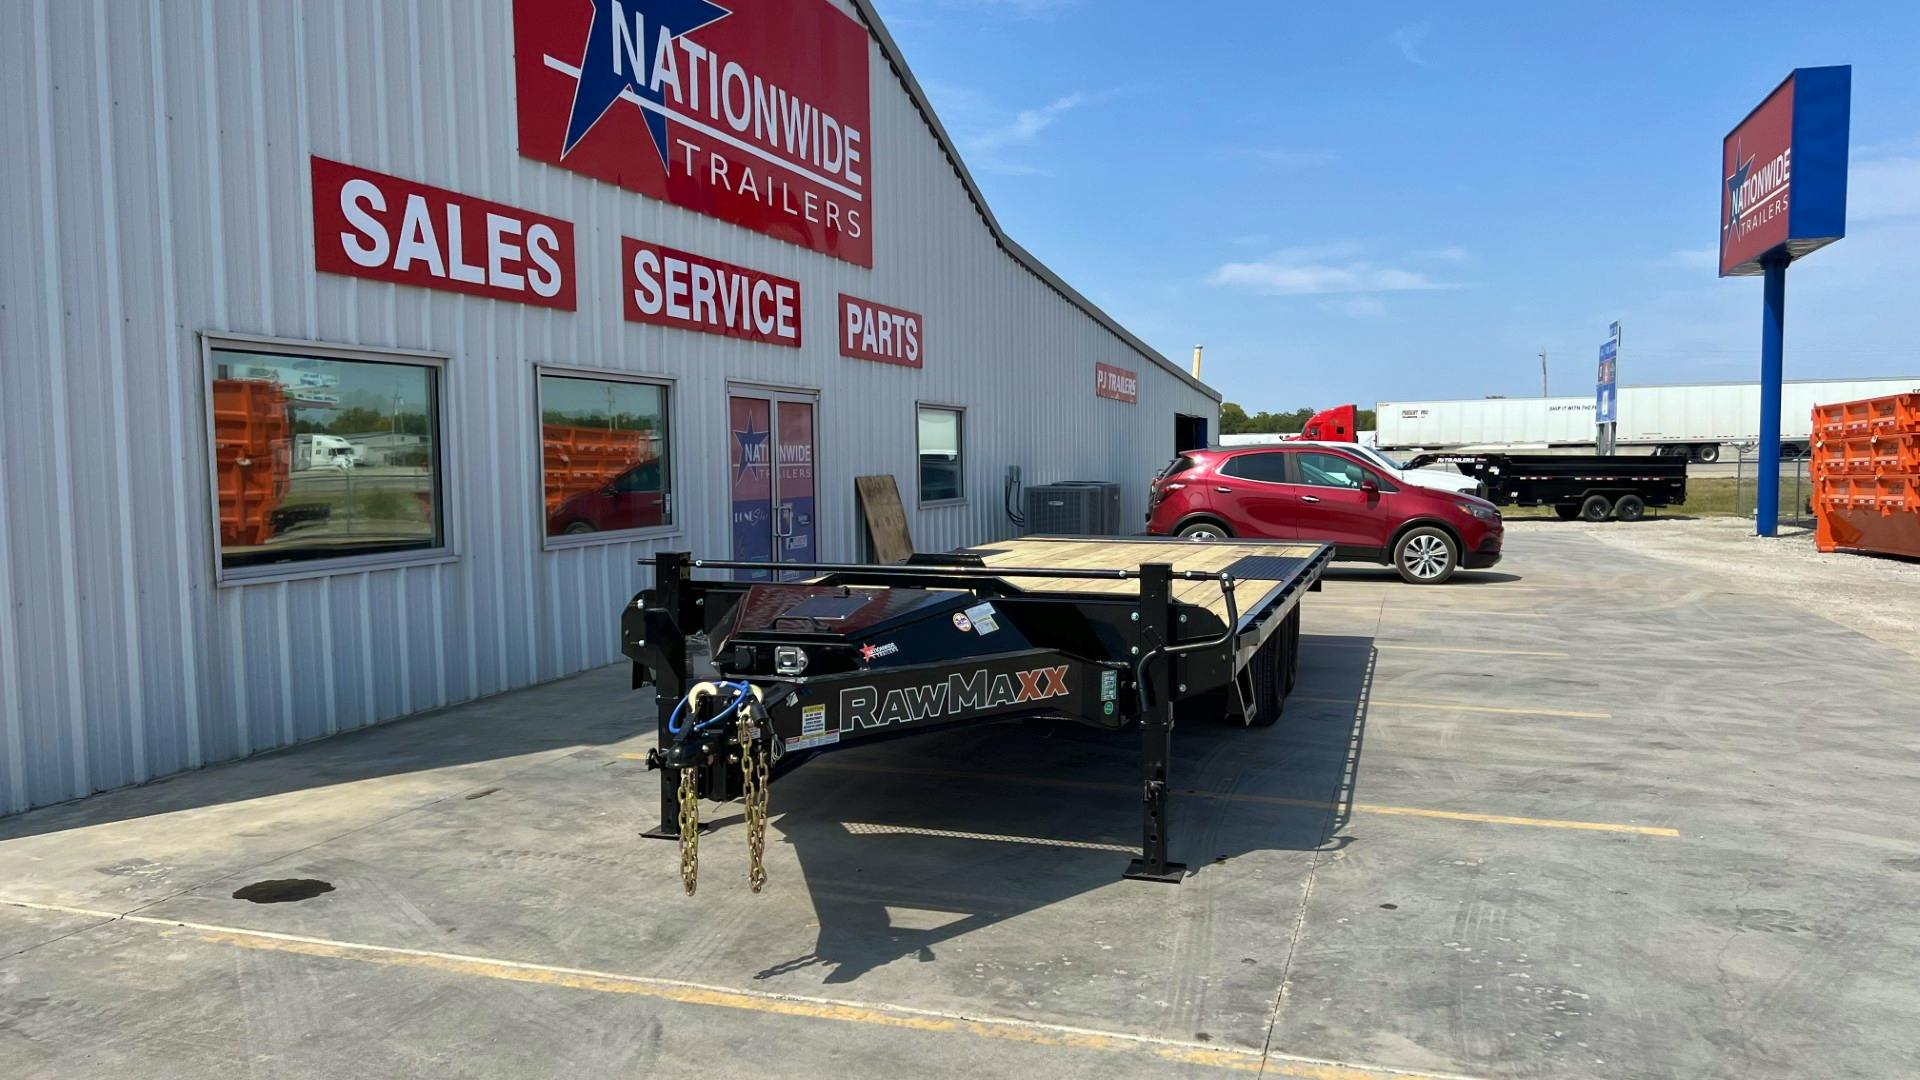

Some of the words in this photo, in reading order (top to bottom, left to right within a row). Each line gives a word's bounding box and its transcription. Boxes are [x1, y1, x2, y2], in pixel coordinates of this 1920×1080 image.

[612, 0, 862, 187] NATIONWIDE
[676, 138, 862, 239] TRAILERS
[1731, 147, 1791, 217] NATIONWIDE
[340, 179, 562, 298] SALES
[1741, 194, 1789, 236] TRAILERS
[634, 249, 796, 338] SERVICE
[846, 303, 919, 361] PARTS
[1097, 370, 1107, 389] PJ
[1108, 372, 1136, 396] TRAILERS
[745, 443, 811, 462] NATINWIDE
[760, 468, 811, 479] TRILERS
